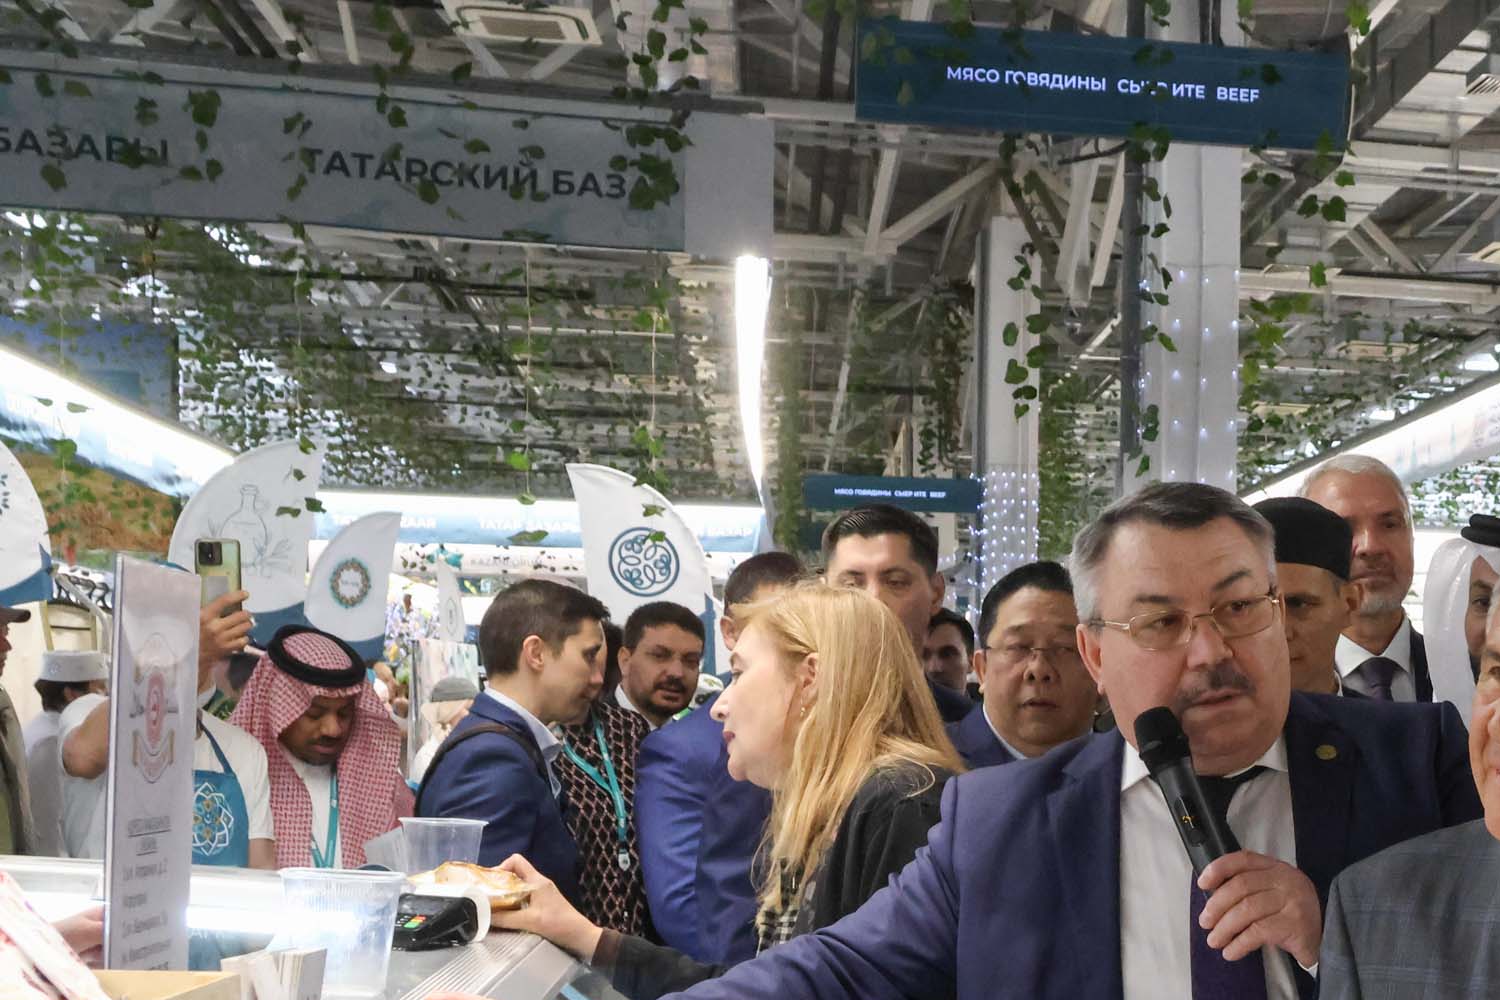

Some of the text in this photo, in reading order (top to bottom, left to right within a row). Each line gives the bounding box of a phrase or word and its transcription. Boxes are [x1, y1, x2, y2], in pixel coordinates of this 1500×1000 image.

[946, 65, 1000, 83] МЯСО
[1004, 69, 1106, 91] ГОВЯДИНЫ
[1172, 83, 1206, 99] ИТЕ
[1216, 87, 1260, 103] BEEF
